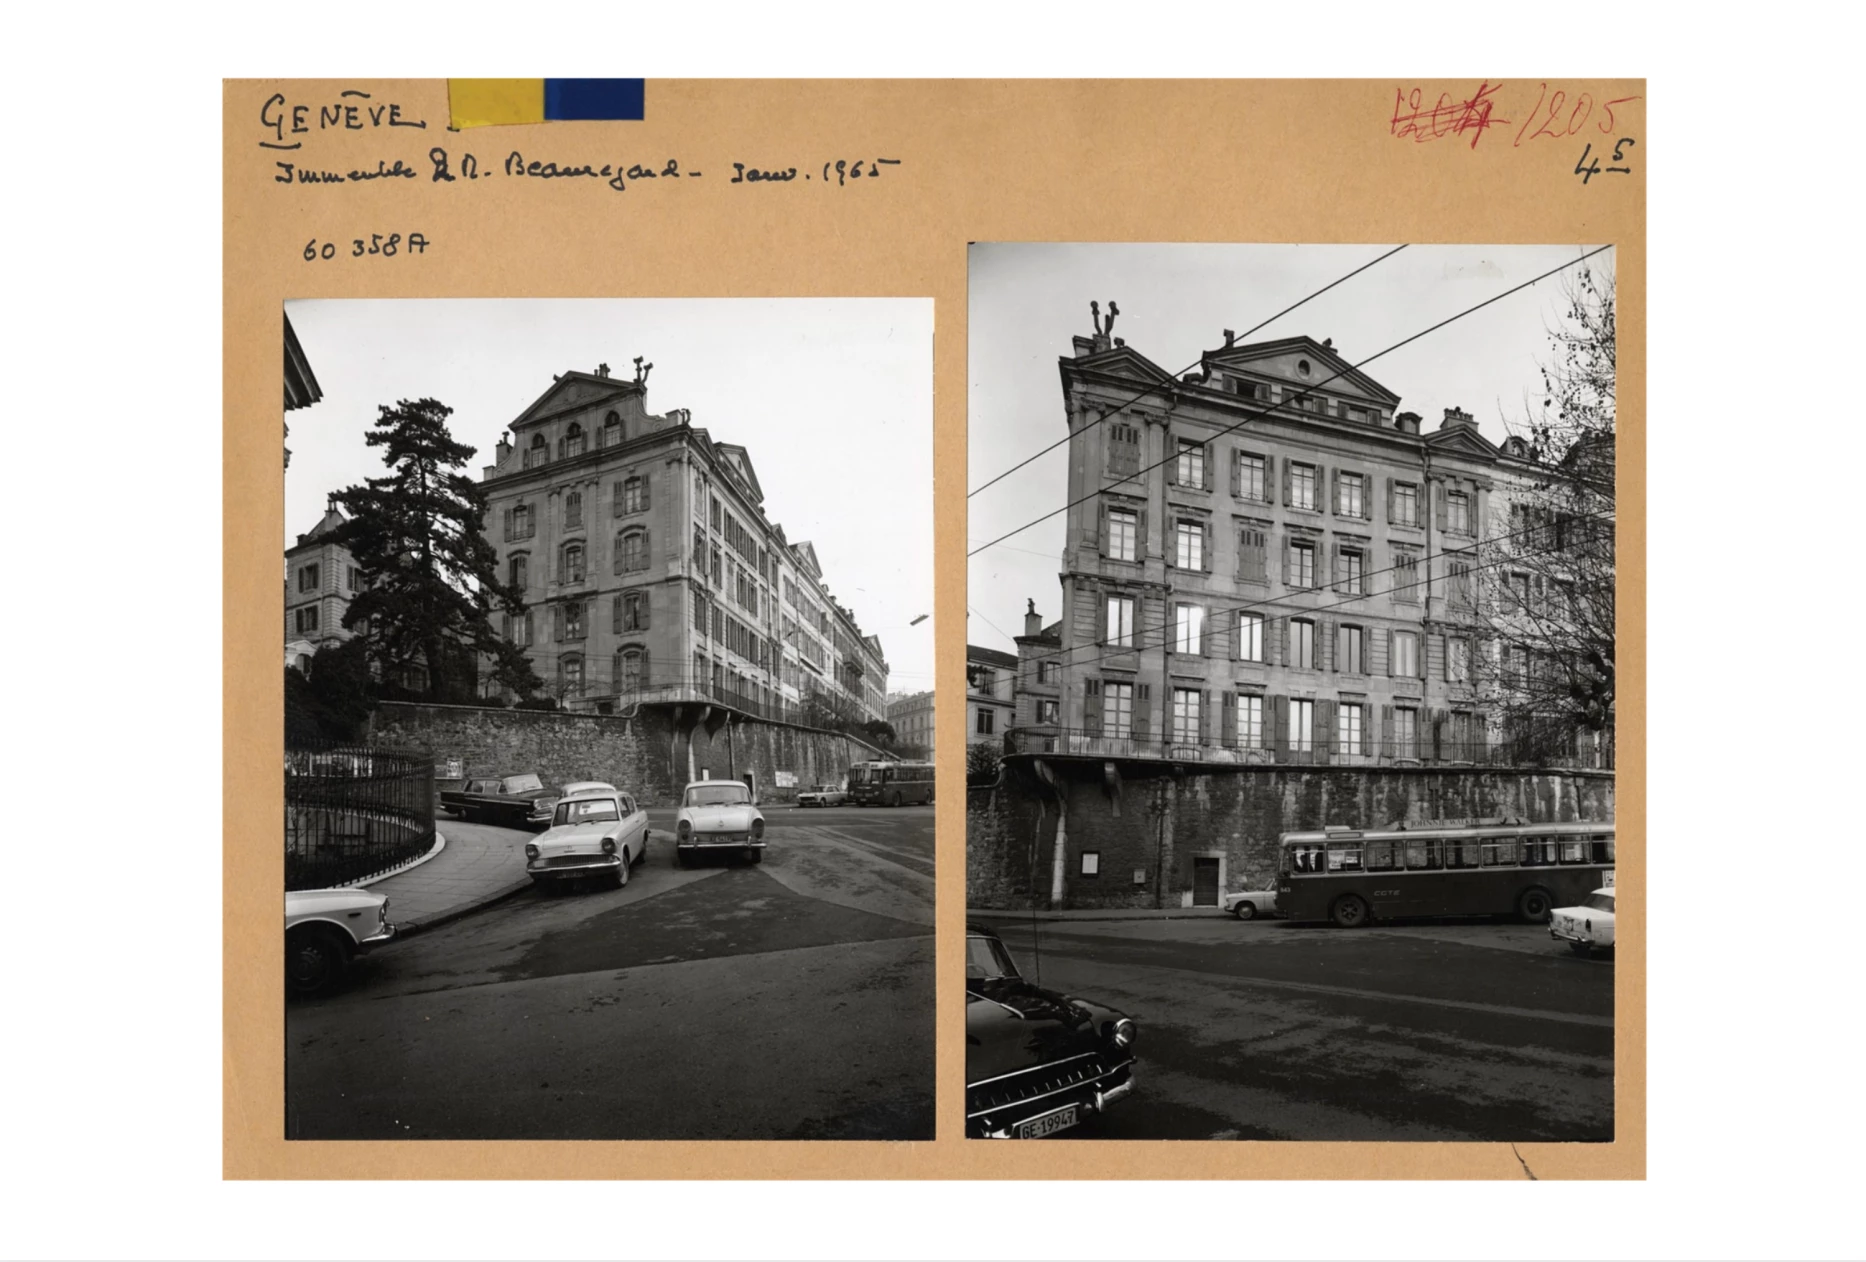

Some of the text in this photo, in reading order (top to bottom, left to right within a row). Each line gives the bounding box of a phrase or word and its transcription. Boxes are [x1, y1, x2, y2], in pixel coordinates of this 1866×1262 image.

[1514, 83, 1641, 147] 1205
[823, 158, 901, 186] 1965
[303, 239, 335, 261] 60
